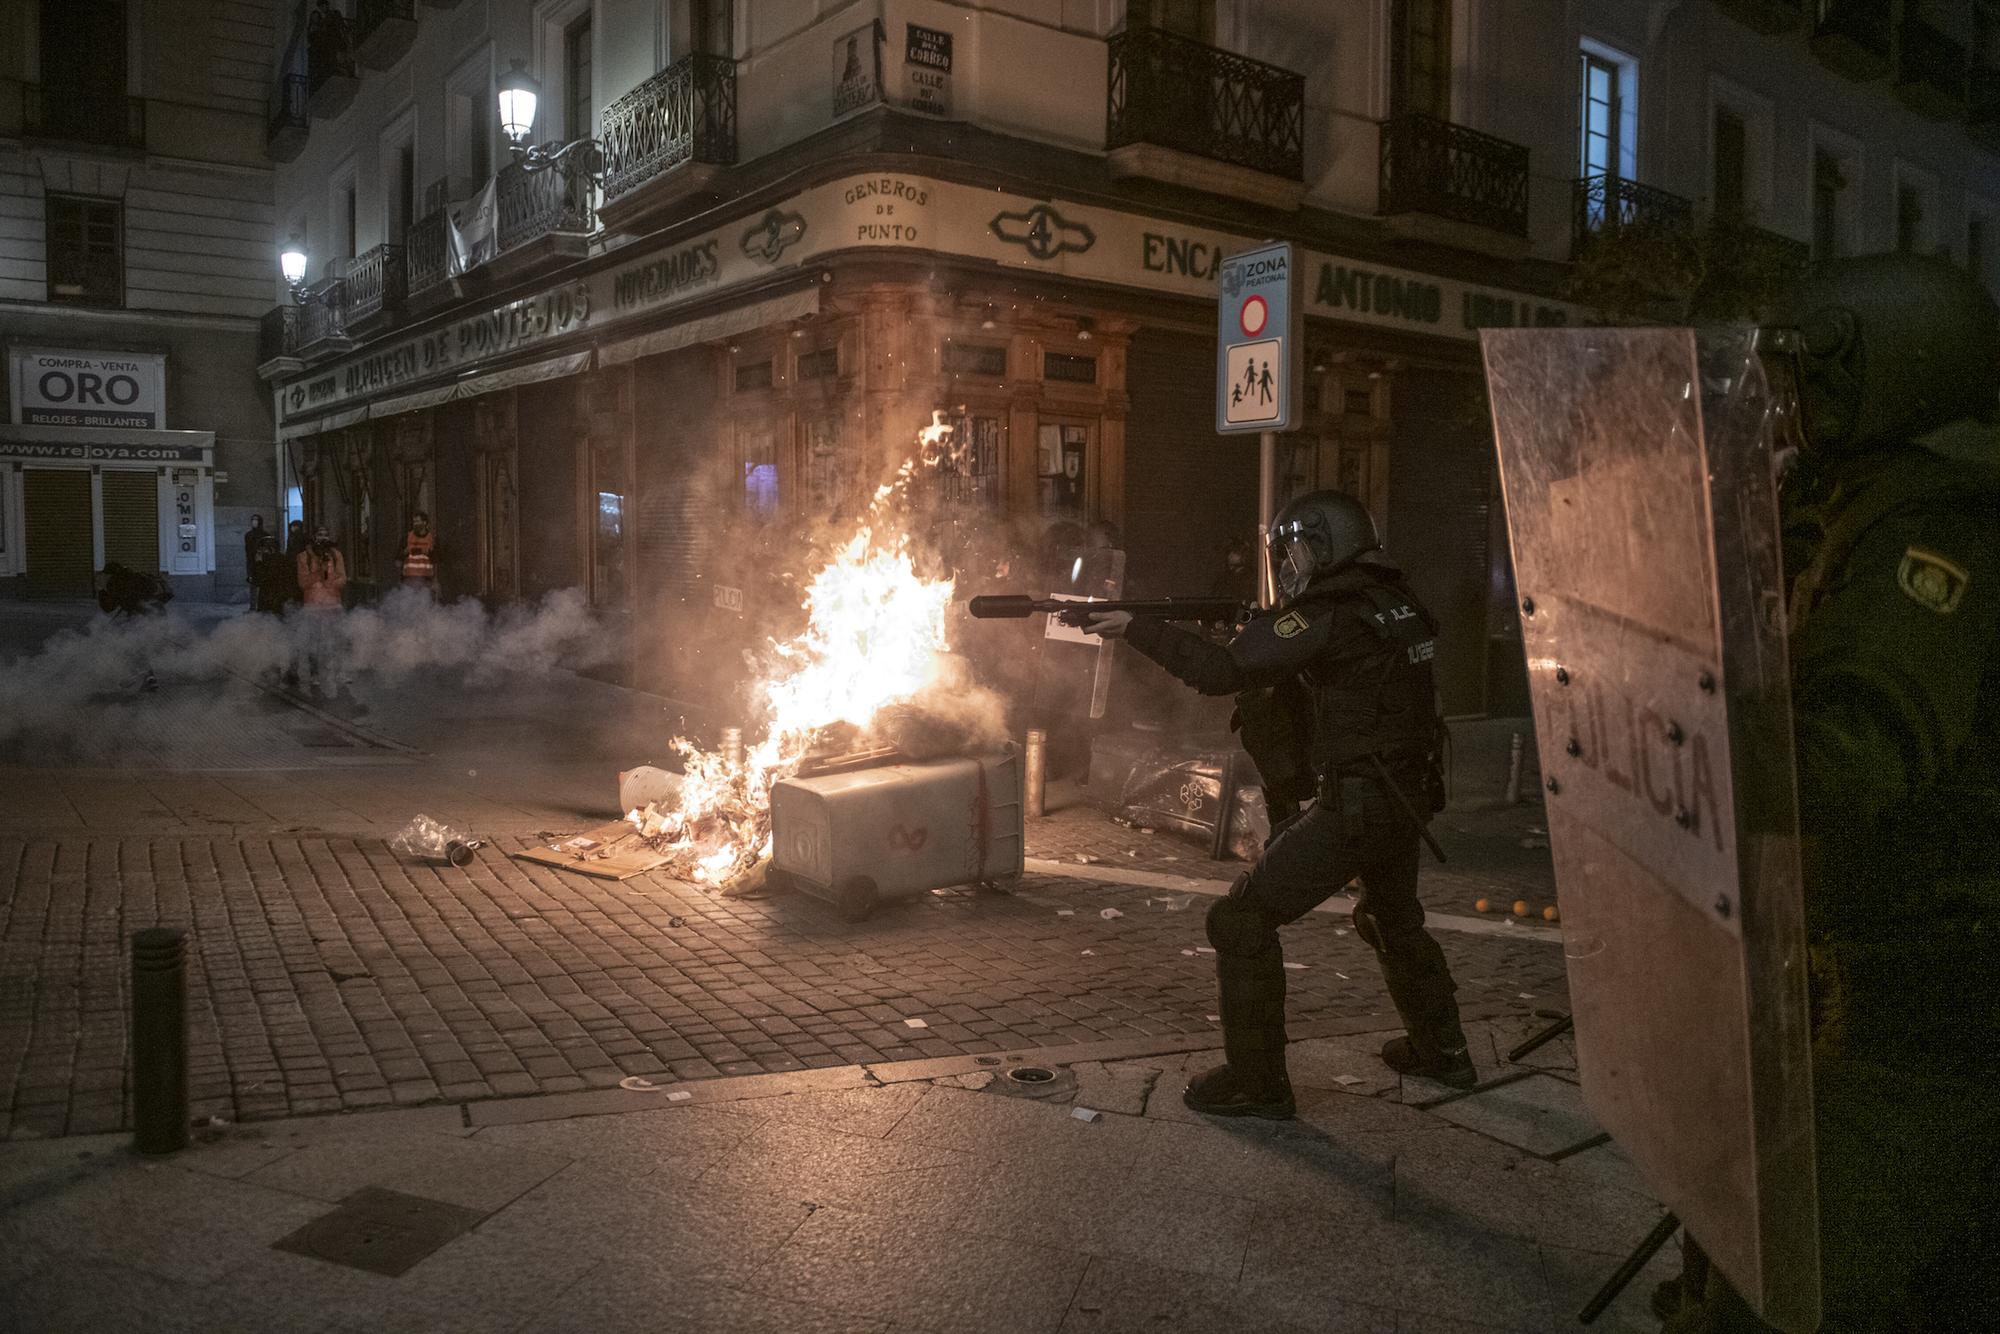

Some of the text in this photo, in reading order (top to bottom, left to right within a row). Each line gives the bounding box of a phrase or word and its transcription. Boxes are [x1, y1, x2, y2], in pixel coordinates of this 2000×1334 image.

[909, 47, 949, 68] CORREO
[911, 72, 943, 89] CALLE
[845, 179, 928, 206] GENEROS
[876, 205, 894, 215] DE
[858, 225, 917, 241] PUNTO
[614, 239, 719, 309] NOVEDADES
[1246, 256, 1287, 277] ZONA
[1246, 272, 1287, 287] PEATONAL
[1315, 262, 1441, 323] ANTONIO
[423, 331, 450, 368] DE
[458, 284, 592, 348] PONTEJOS
[38, 358, 92, 369] COMPRA
[101, 361, 139, 372] VENTA
[39, 371, 140, 405] ORO
[32, 414, 77, 425] RELOJES
[85, 417, 148, 427] BRILLANTES
[0, 444, 180, 459] www.rejoya.com
